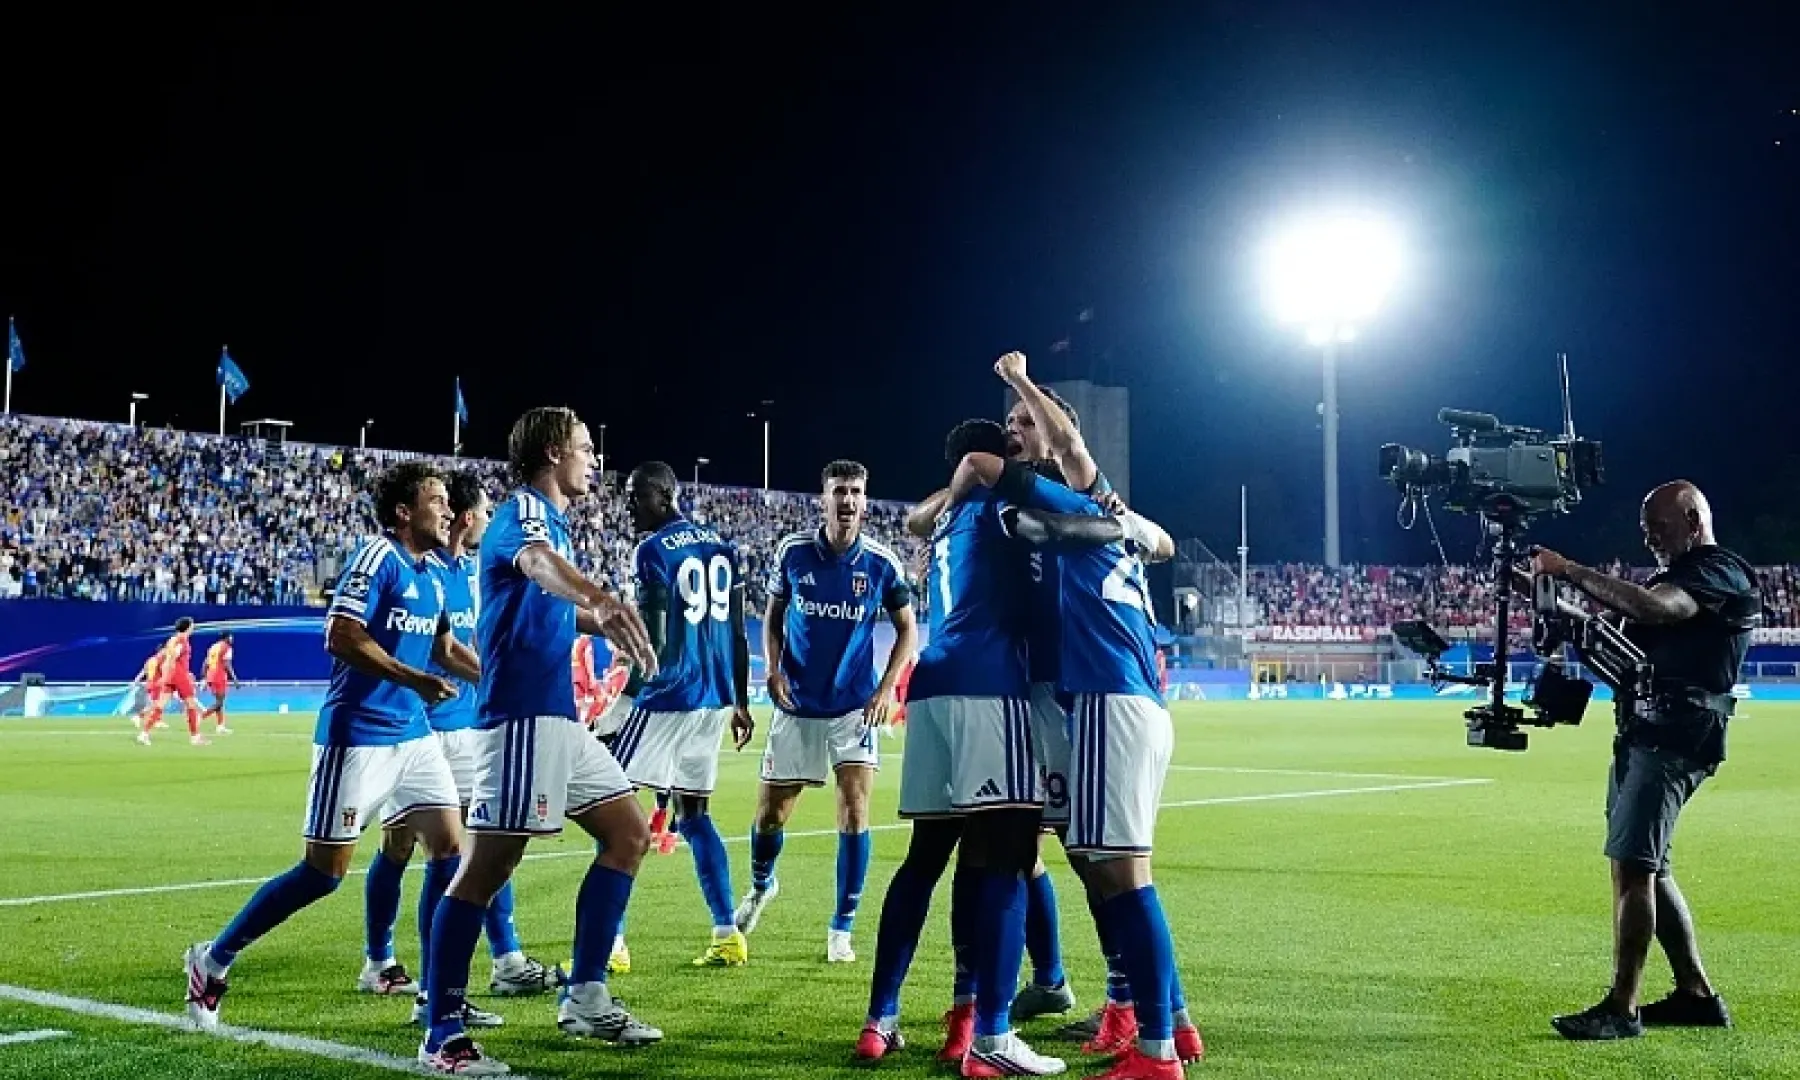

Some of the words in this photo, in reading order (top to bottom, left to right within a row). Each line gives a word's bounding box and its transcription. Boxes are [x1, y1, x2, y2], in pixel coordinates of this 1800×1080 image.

[677, 553, 732, 624] 99
[386, 607, 439, 636] Revol
[1349, 683, 1394, 699] PS5
[860, 729, 873, 754] 4
